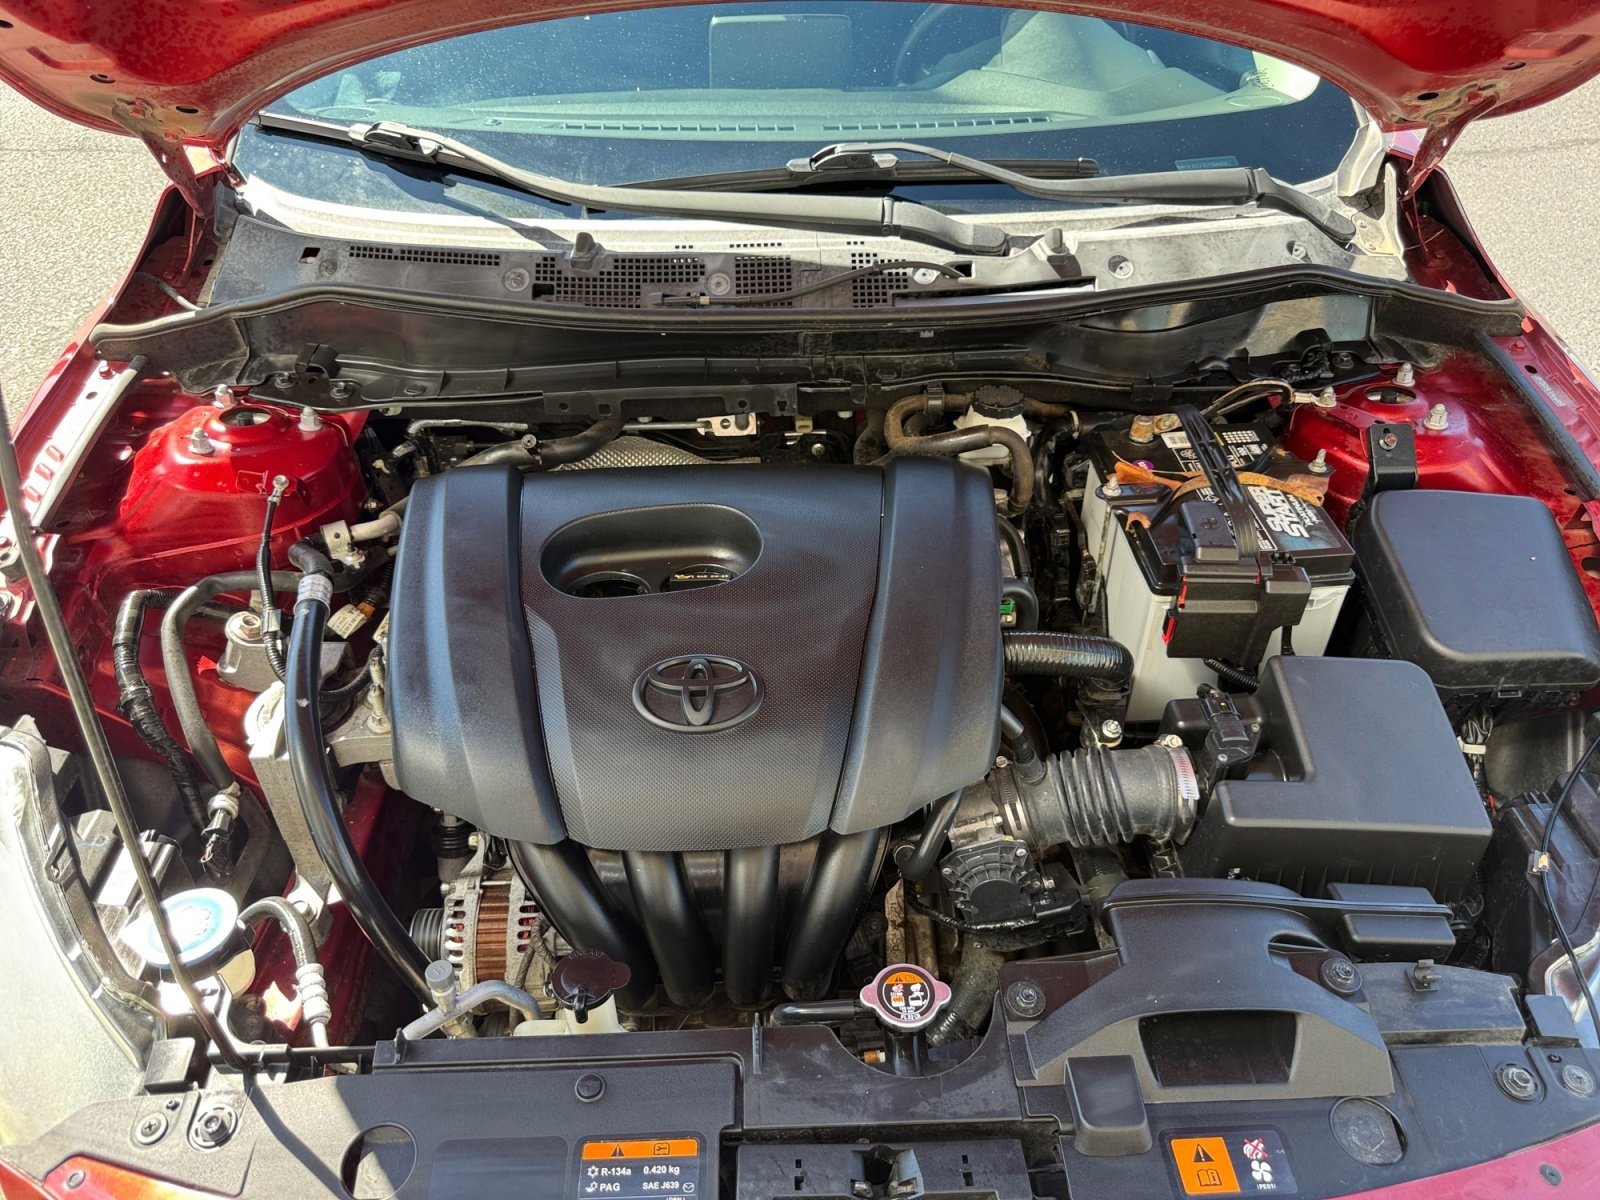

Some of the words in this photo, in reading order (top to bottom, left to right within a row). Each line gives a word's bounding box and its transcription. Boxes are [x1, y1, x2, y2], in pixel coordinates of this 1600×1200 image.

[1247, 486, 1283, 532] SUPER
[1266, 489, 1310, 538] START
[601, 1166, 632, 1176] R-134a
[643, 1165, 667, 1175] 0.420
[668, 1165, 680, 1176] kg
[600, 1183, 621, 1192] PAG
[642, 1182, 660, 1190] SAE
[661, 1180, 680, 1189] J639
